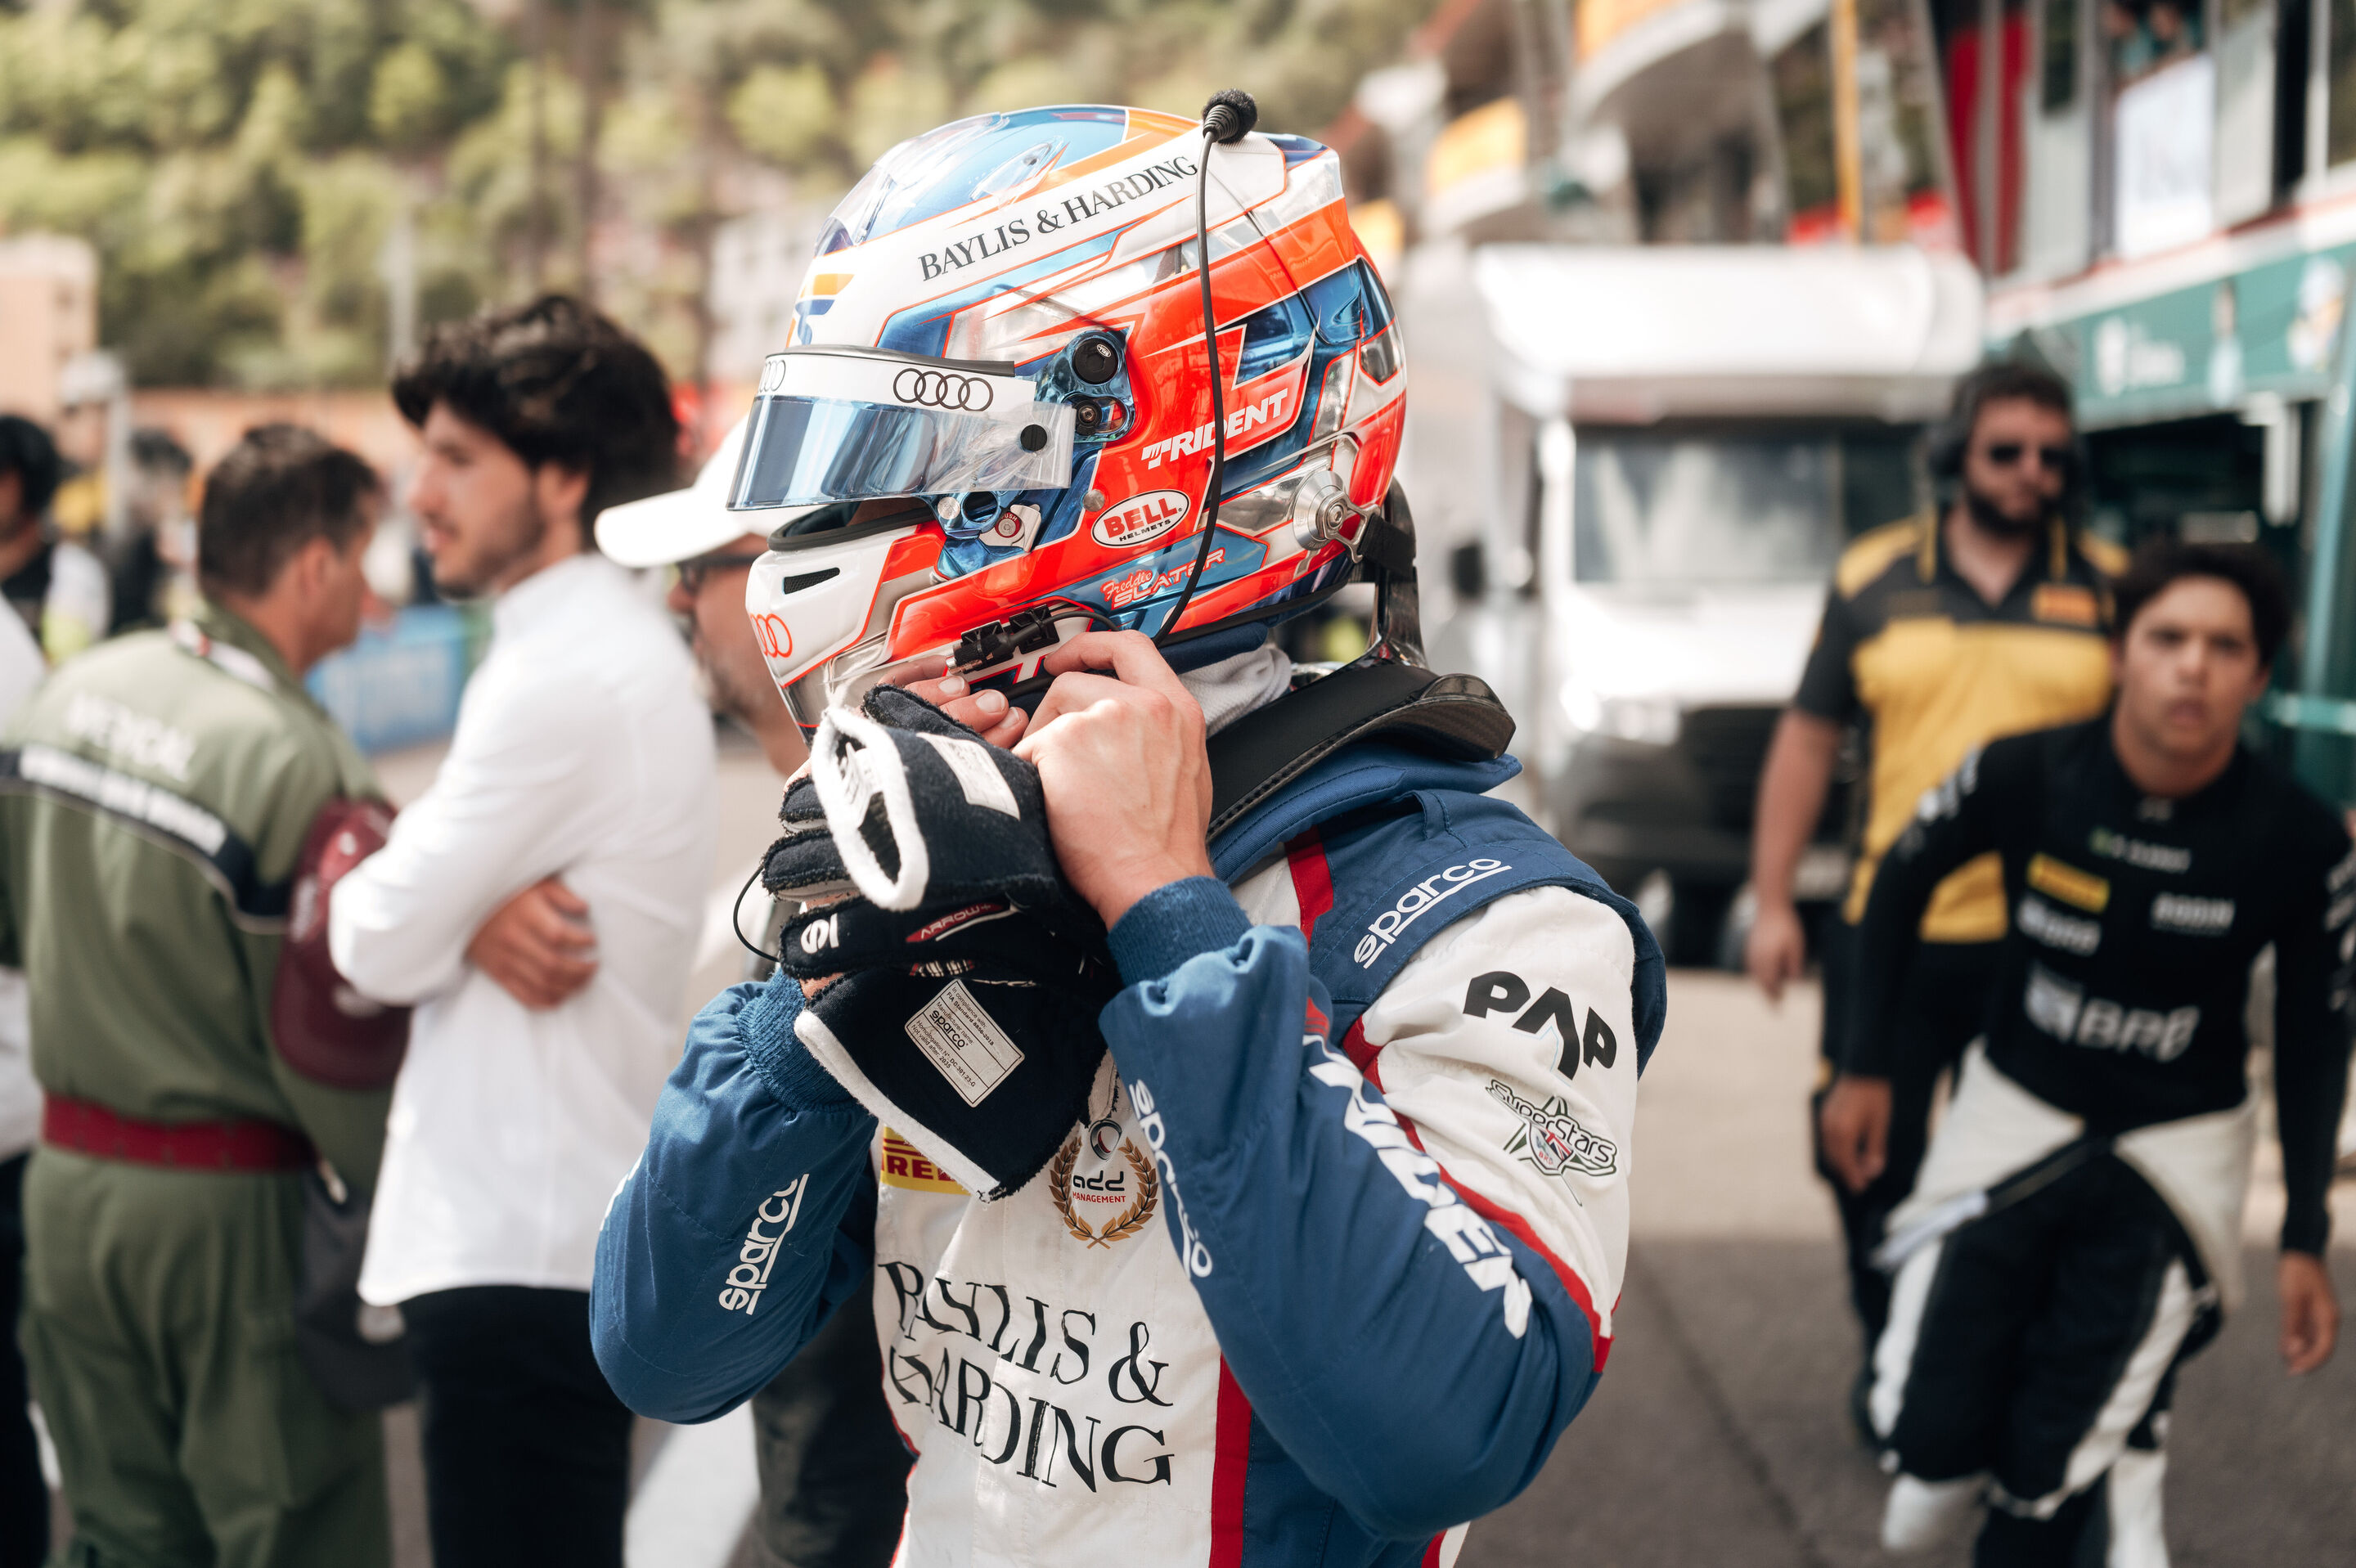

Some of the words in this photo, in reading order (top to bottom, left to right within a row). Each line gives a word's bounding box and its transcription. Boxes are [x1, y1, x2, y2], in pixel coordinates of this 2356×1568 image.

[918, 218, 1031, 281] BAYLIS
[1036, 209, 1065, 235] &
[1060, 156, 1198, 224] HARDING
[1141, 388, 1288, 470] TRIDENT
[1104, 498, 1178, 538] BELL
[1119, 519, 1171, 541] HELMETS
[1101, 570, 1153, 602] Freddie
[1354, 858, 1512, 969] sparco
[936, 1001, 964, 1032] Manufacturer
[946, 991, 955, 1002] FIA
[953, 1000, 973, 1022] Standard
[955, 993, 978, 1019] compliance
[977, 1017, 987, 1028] with:
[910, 1024, 920, 1036] Not
[919, 1032, 930, 1046] valid
[928, 1044, 940, 1056] after:
[939, 1055, 951, 1068] 2035
[915, 1020, 944, 1052] Homologation
[929, 1009, 966, 1050] sparco
[1490, 1080, 1616, 1167] SuperStars
[1072, 1170, 1125, 1192] add
[1072, 1192, 1126, 1203] MANAGEMENT
[1302, 1032, 1533, 1340] RIDEN
[1108, 1321, 1174, 1407] &
